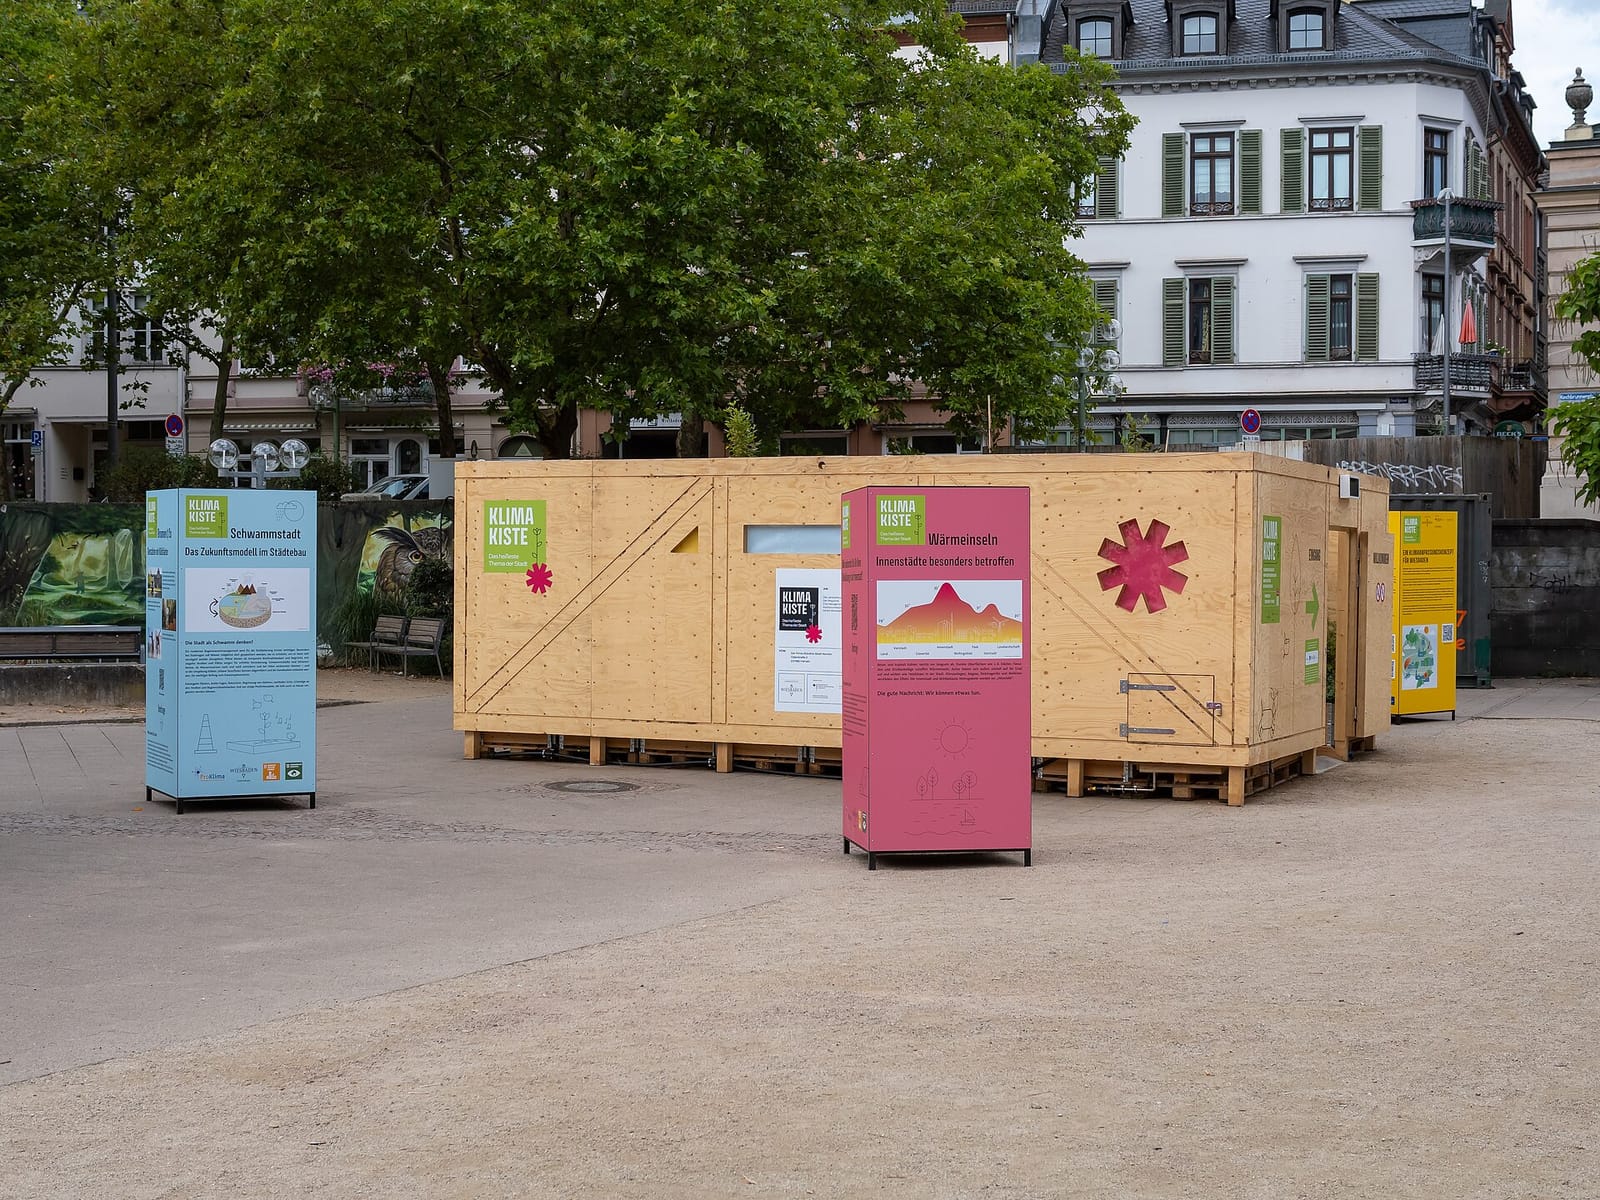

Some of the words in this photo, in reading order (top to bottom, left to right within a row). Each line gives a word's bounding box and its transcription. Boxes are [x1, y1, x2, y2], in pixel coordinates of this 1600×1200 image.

[189, 499, 220, 511] KLIMA
[880, 500, 916, 513] KLIMA
[189, 512, 216, 523] KISTE
[489, 507, 534, 525] KLIMA
[880, 514, 912, 527] KISTE
[230, 528, 301, 540] Schwammstadt
[1263, 520, 1278, 539] KLIMA
[1404, 526, 1417, 534] KISTE
[489, 527, 529, 545] KISTE
[928, 533, 998, 546] Wärmeinseln
[184, 547, 199, 557] Das
[200, 546, 258, 557] Zukunftsmodell
[258, 548, 269, 557] im
[269, 546, 307, 557] Städtebau
[1263, 542, 1276, 561] KISTE
[876, 556, 927, 567] Innenstädte
[929, 556, 973, 567] besonders
[975, 556, 1015, 567] betroffen
[782, 591, 811, 603] KLIMA
[782, 604, 808, 615] KISTE
[886, 690, 899, 698] gute
[935, 689, 954, 697] können
